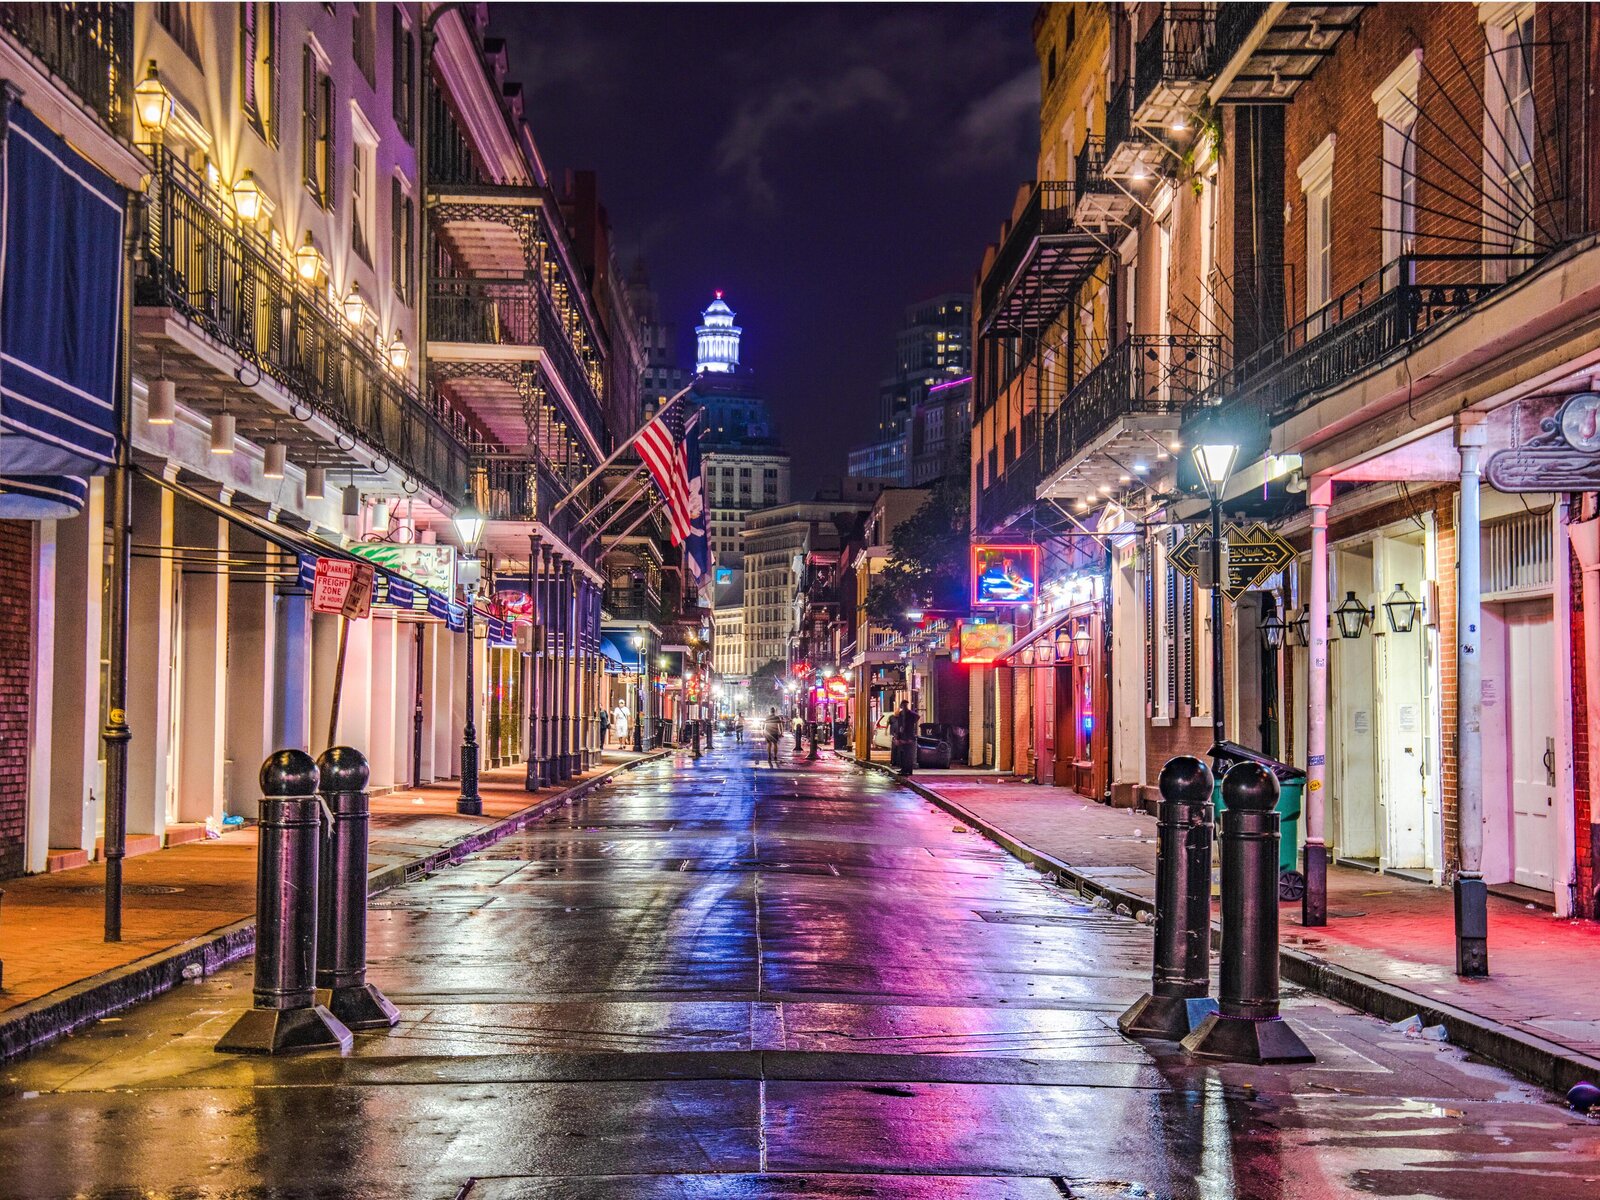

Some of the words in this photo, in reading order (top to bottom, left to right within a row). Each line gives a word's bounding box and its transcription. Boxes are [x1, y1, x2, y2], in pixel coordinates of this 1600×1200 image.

[316, 561, 328, 573] NO
[328, 565, 352, 574] PARKING
[318, 577, 349, 587] FREIGHT
[322, 586, 342, 595] ZONE
